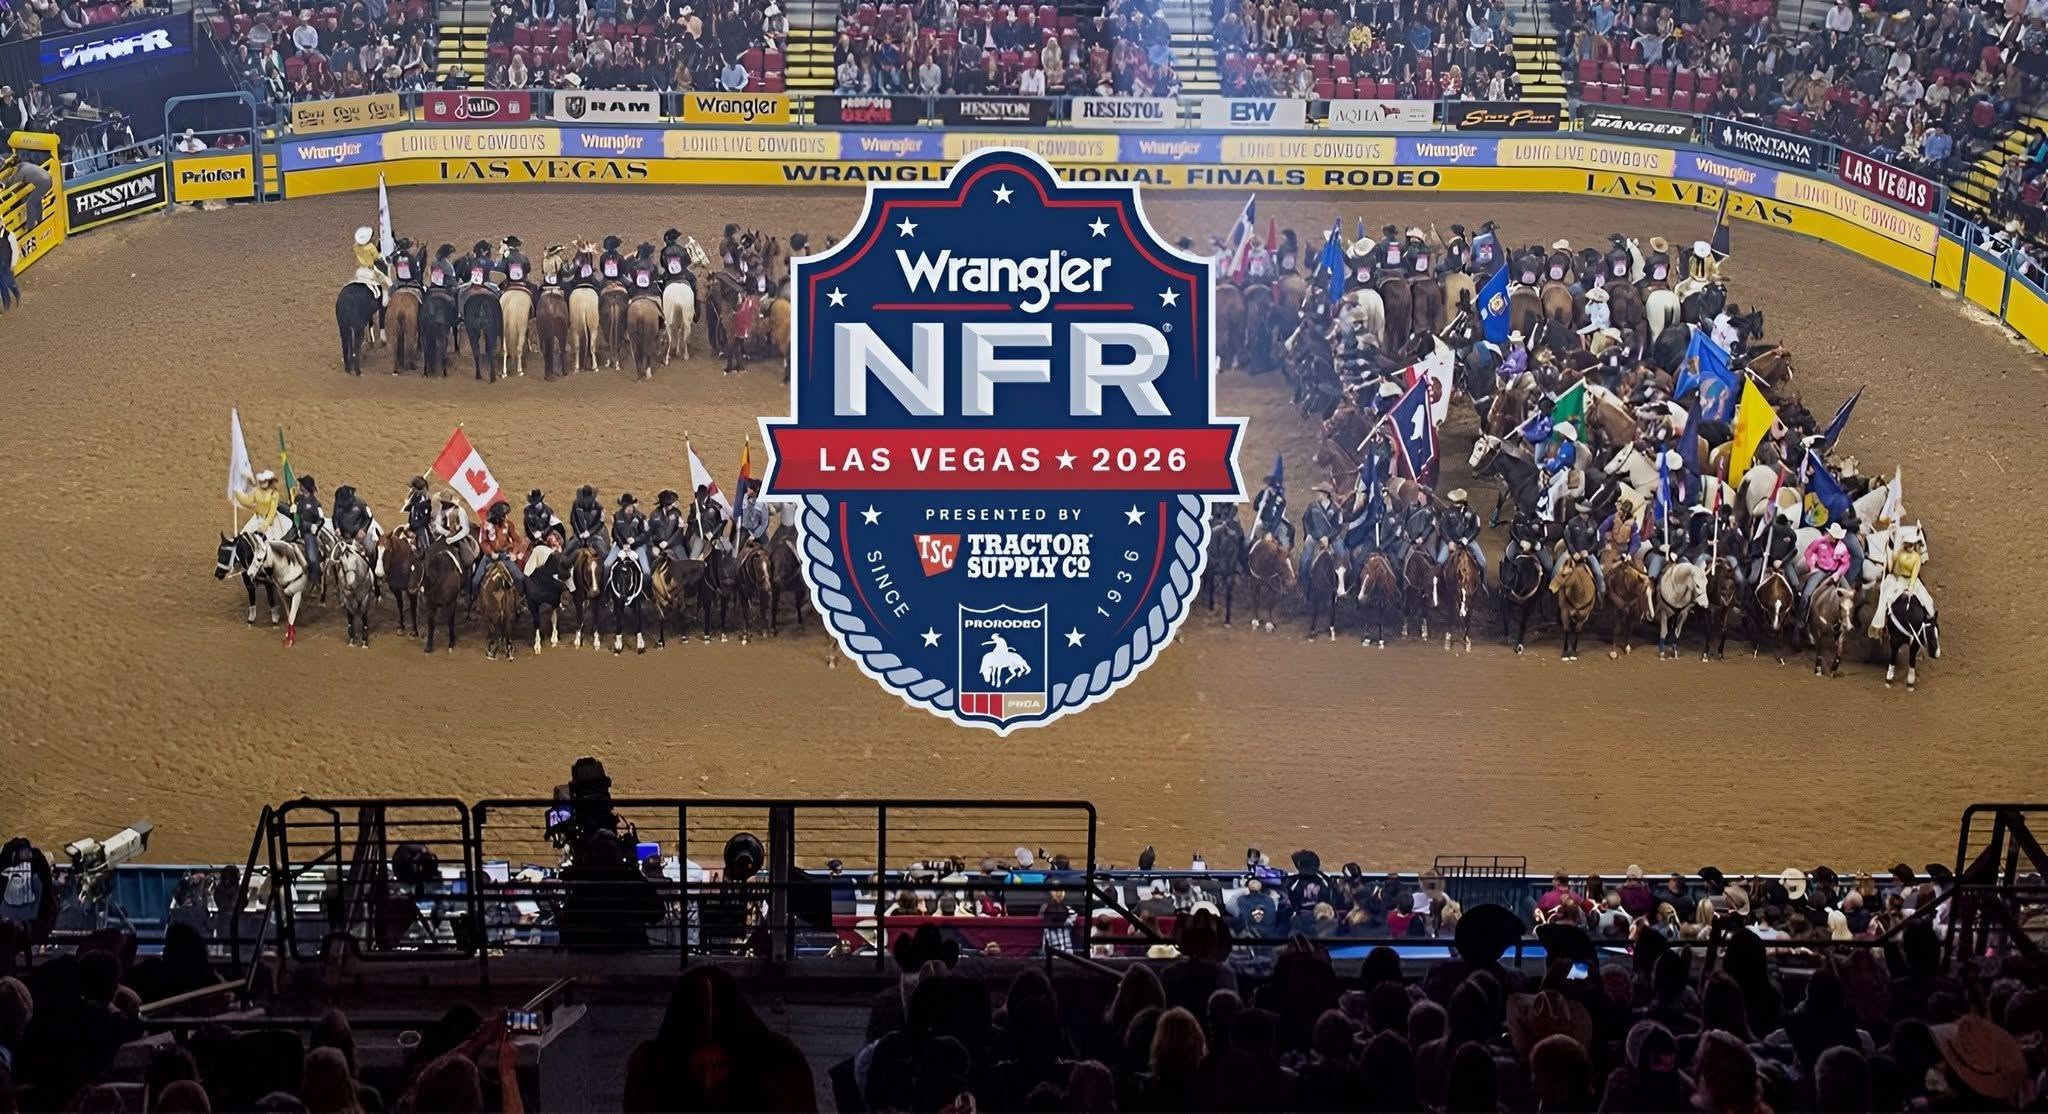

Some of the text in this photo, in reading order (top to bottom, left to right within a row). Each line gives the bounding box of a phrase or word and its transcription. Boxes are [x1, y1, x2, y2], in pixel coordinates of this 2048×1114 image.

[590, 101, 650, 112] RAM
[696, 96, 778, 121] Wrangler
[960, 102, 1031, 116] HESSTON
[1083, 102, 1164, 119] RESISTOL
[1735, 129, 1811, 159] MONTANA
[439, 160, 648, 179] LAS VEGAS
[1187, 168, 1305, 185] FINALS
[1324, 170, 1441, 187] RODEO
[1586, 174, 1657, 197] LAS
[1844, 155, 1927, 207] LAS VEGAS
[75, 173, 156, 214] HESSTON
